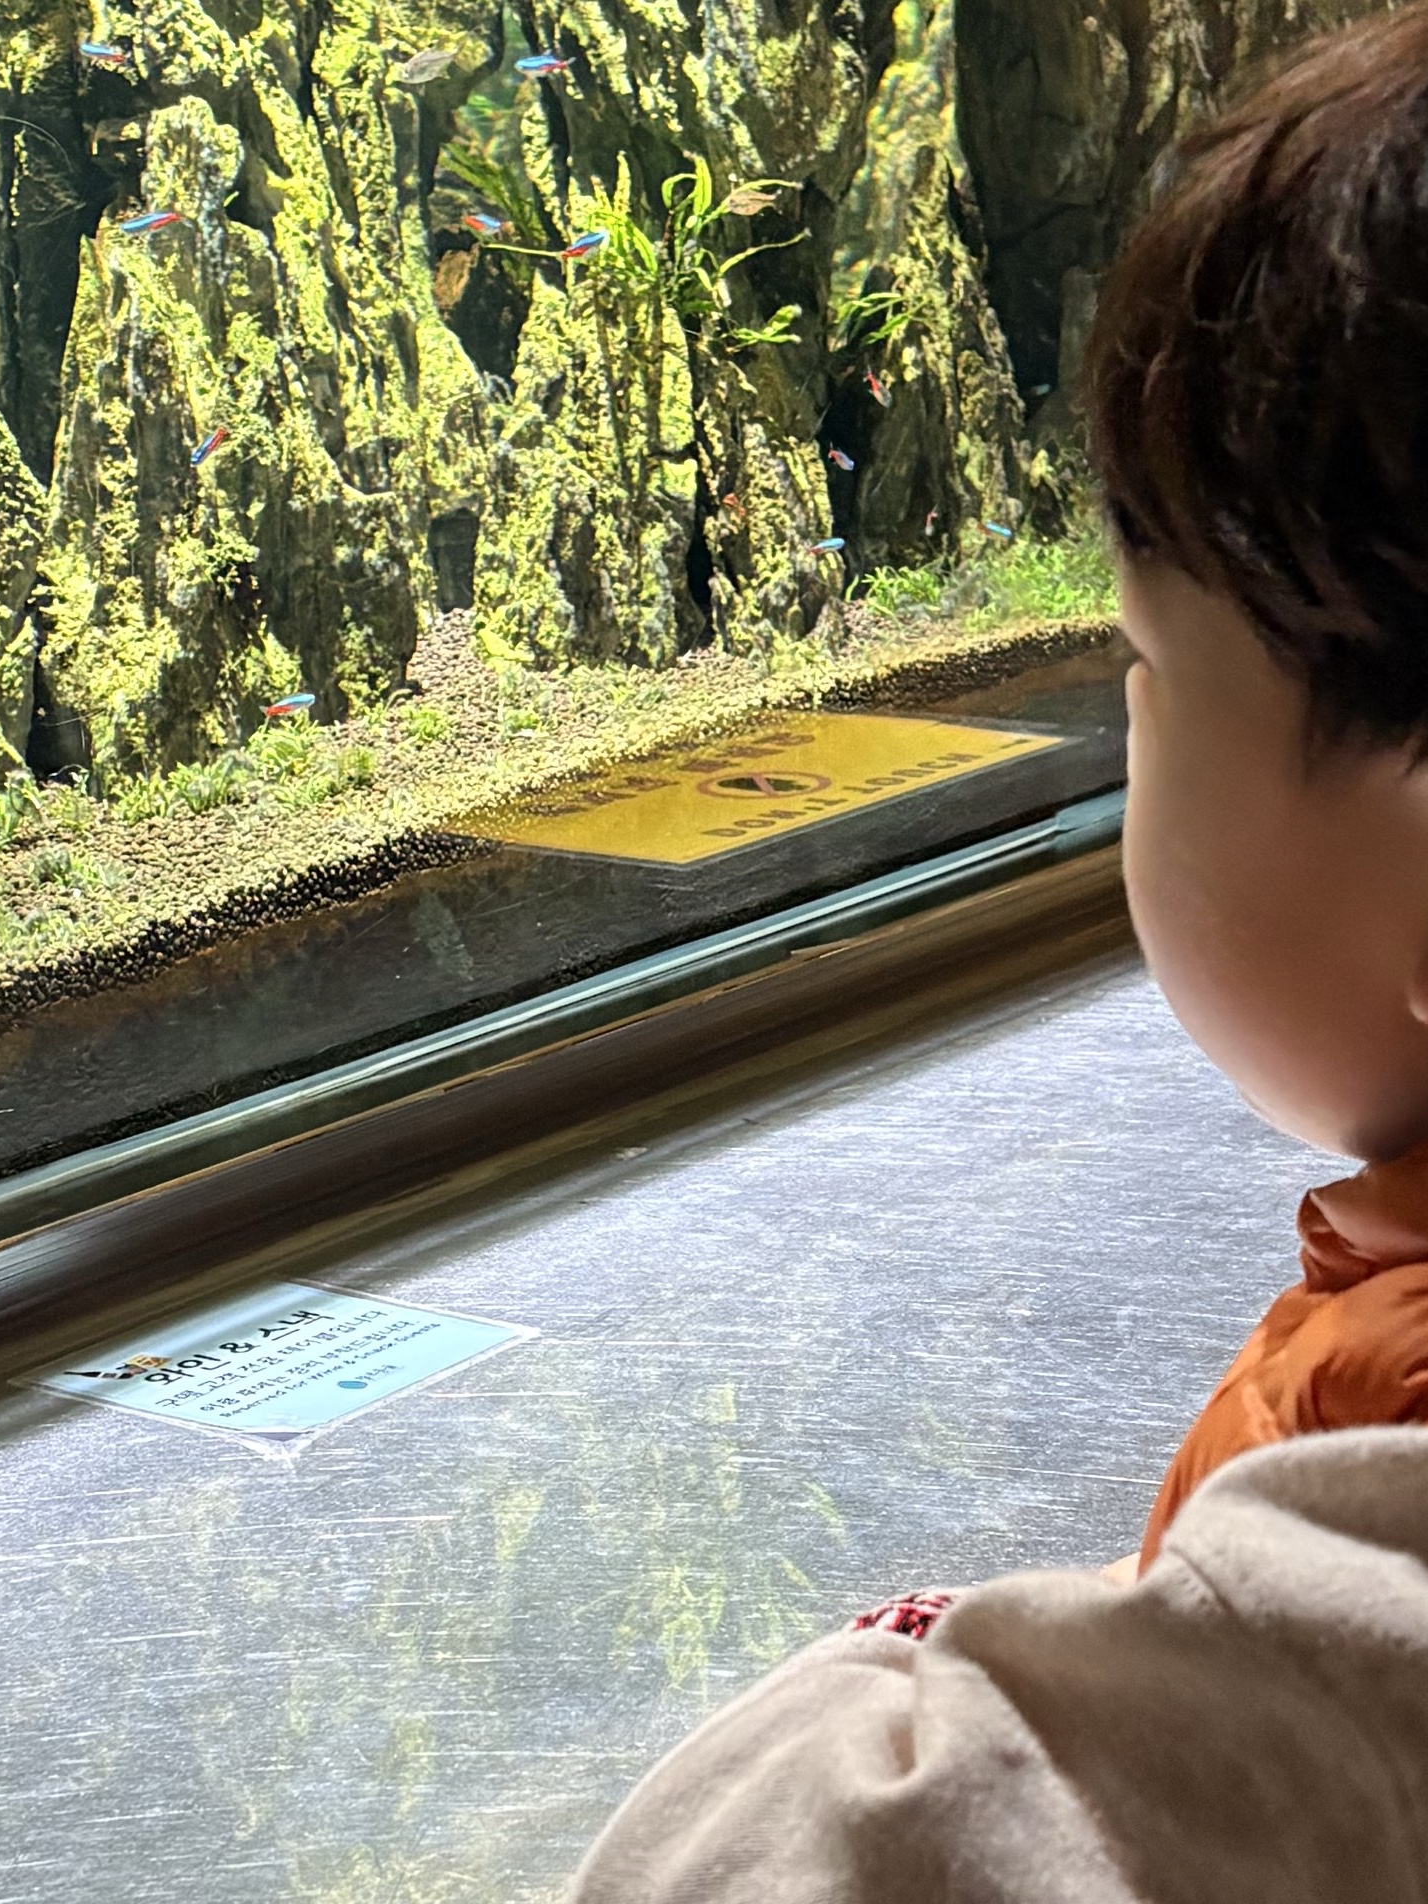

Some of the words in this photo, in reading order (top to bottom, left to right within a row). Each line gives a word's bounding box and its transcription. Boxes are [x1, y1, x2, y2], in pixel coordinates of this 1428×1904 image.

[144, 1354, 230, 1384] 와인
[219, 1342, 260, 1353] &
[259, 1310, 333, 1340] 스낵
